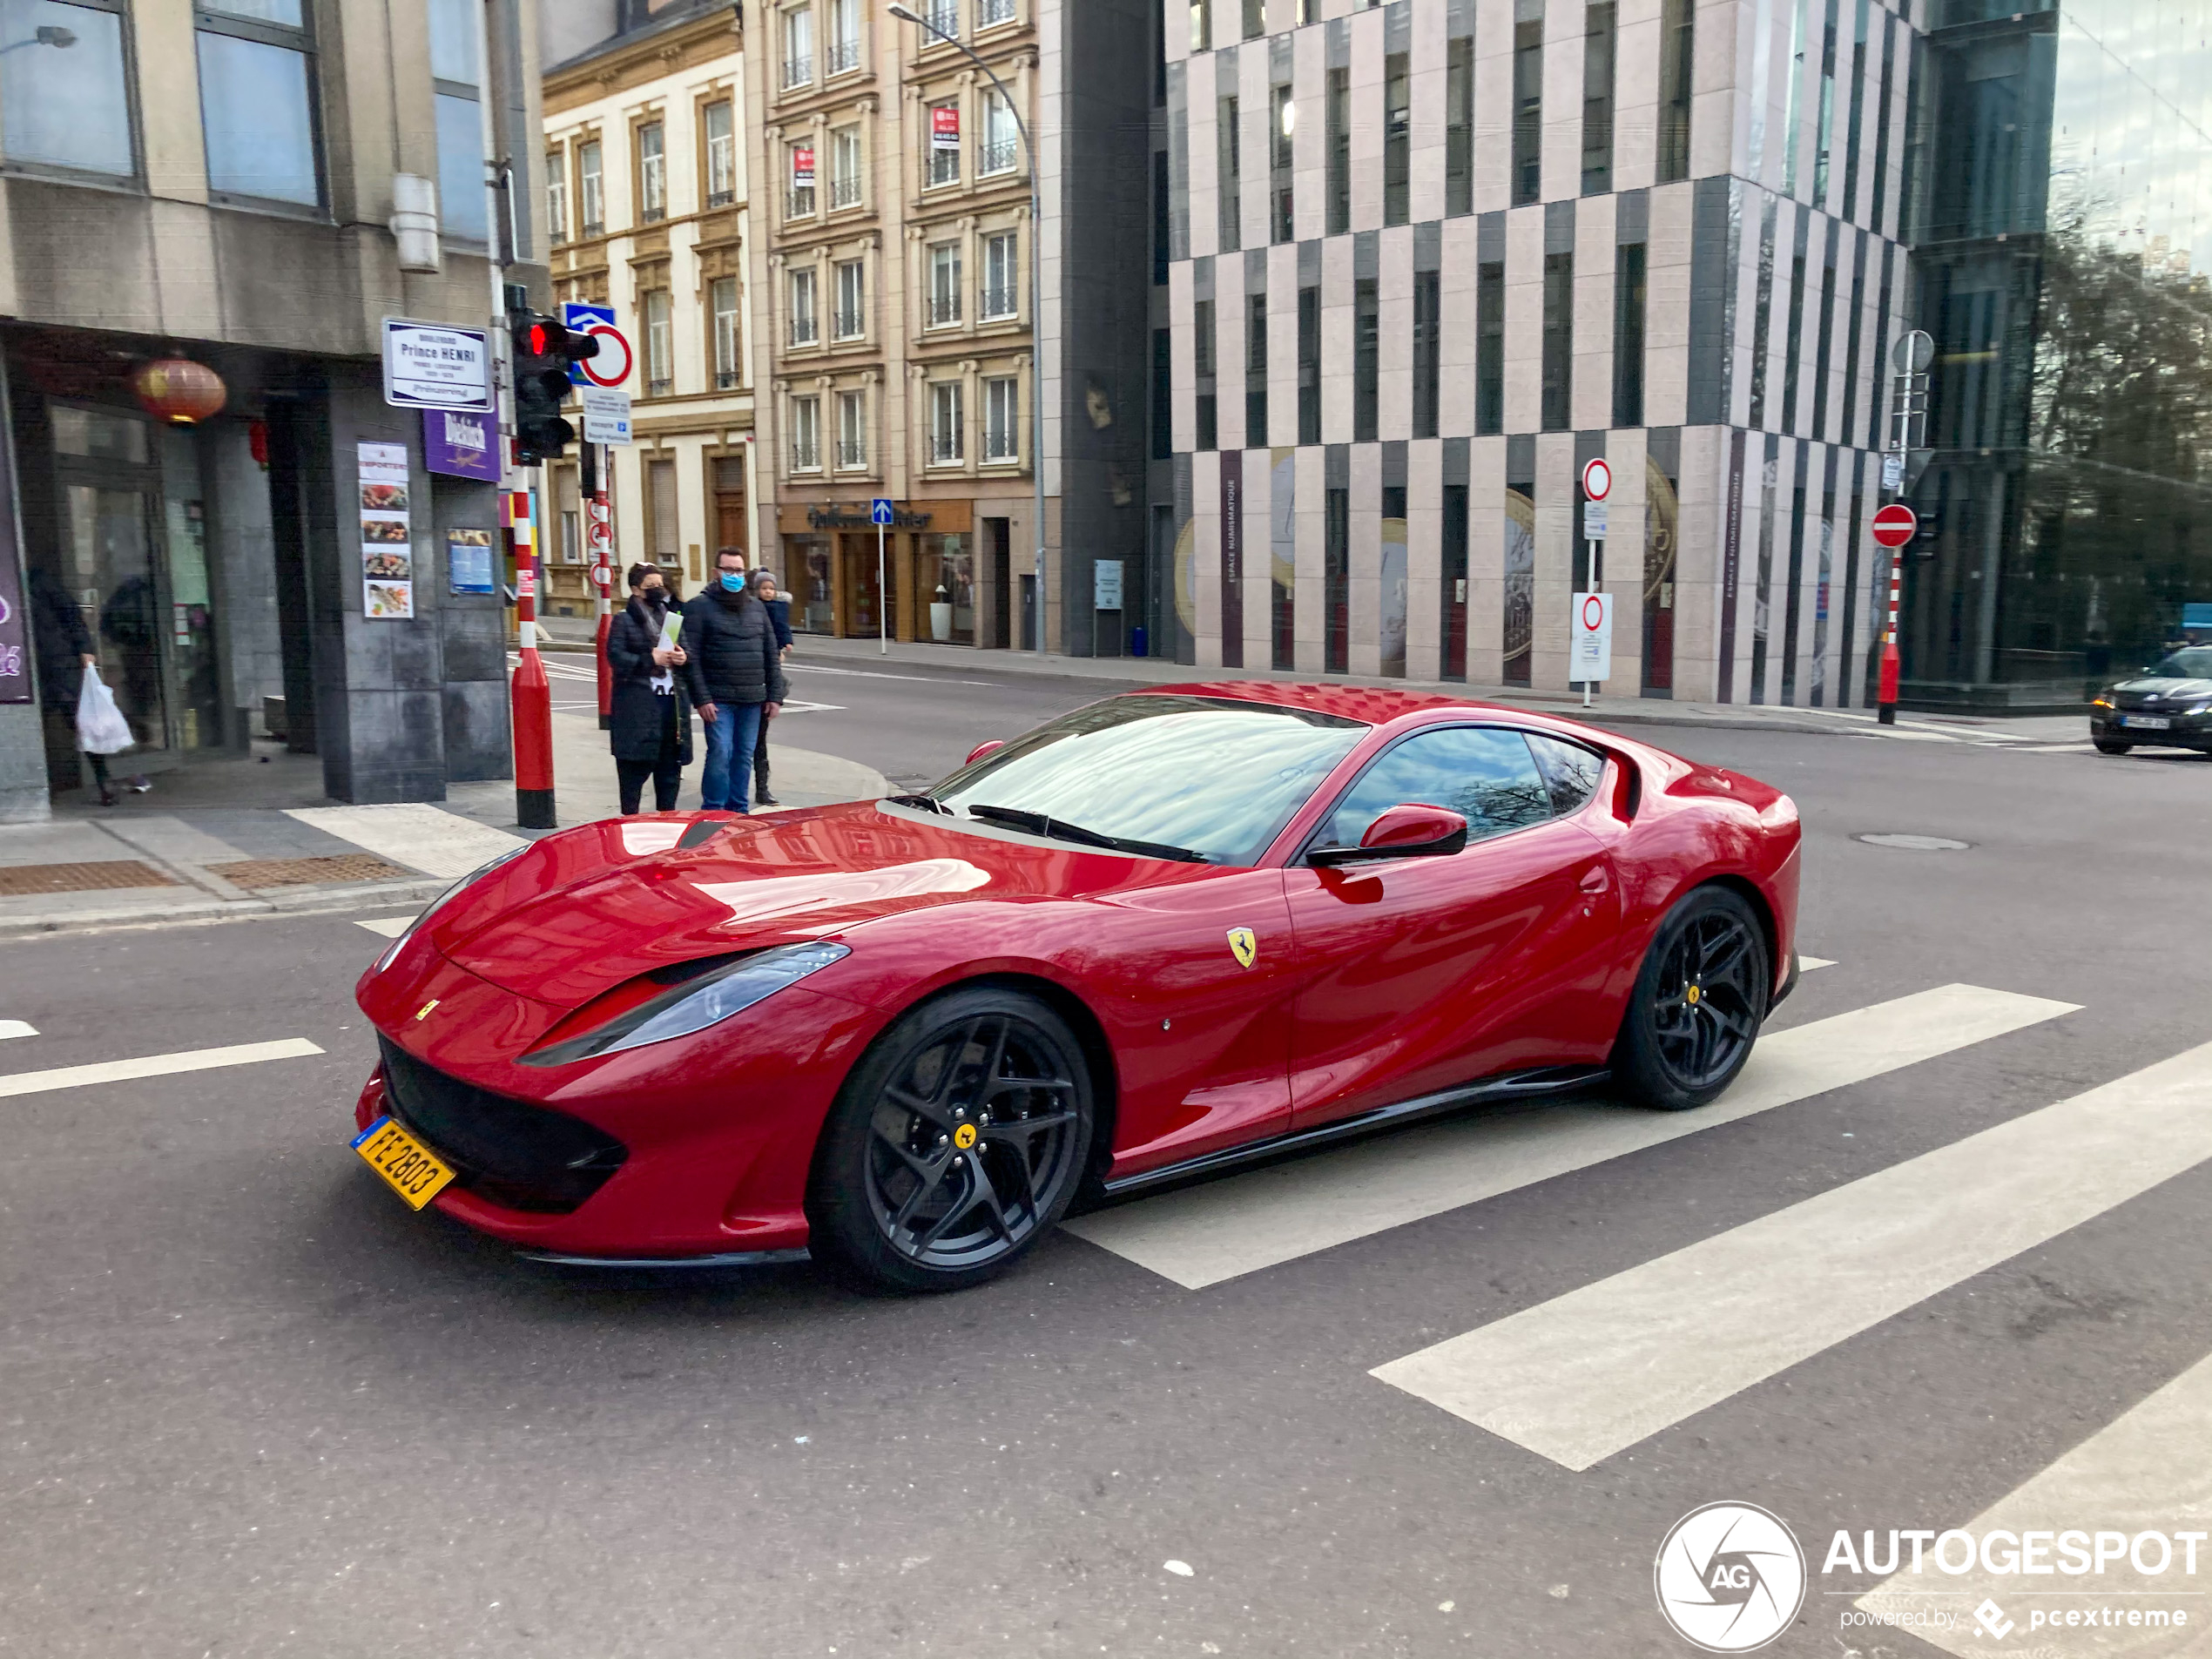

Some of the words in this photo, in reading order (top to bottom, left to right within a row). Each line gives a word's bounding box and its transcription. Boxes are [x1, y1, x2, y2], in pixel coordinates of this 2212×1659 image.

[401, 343, 437, 359] Prince
[441, 348, 475, 362] HENRI
[1227, 479, 1236, 550] NUMISMATIQUE
